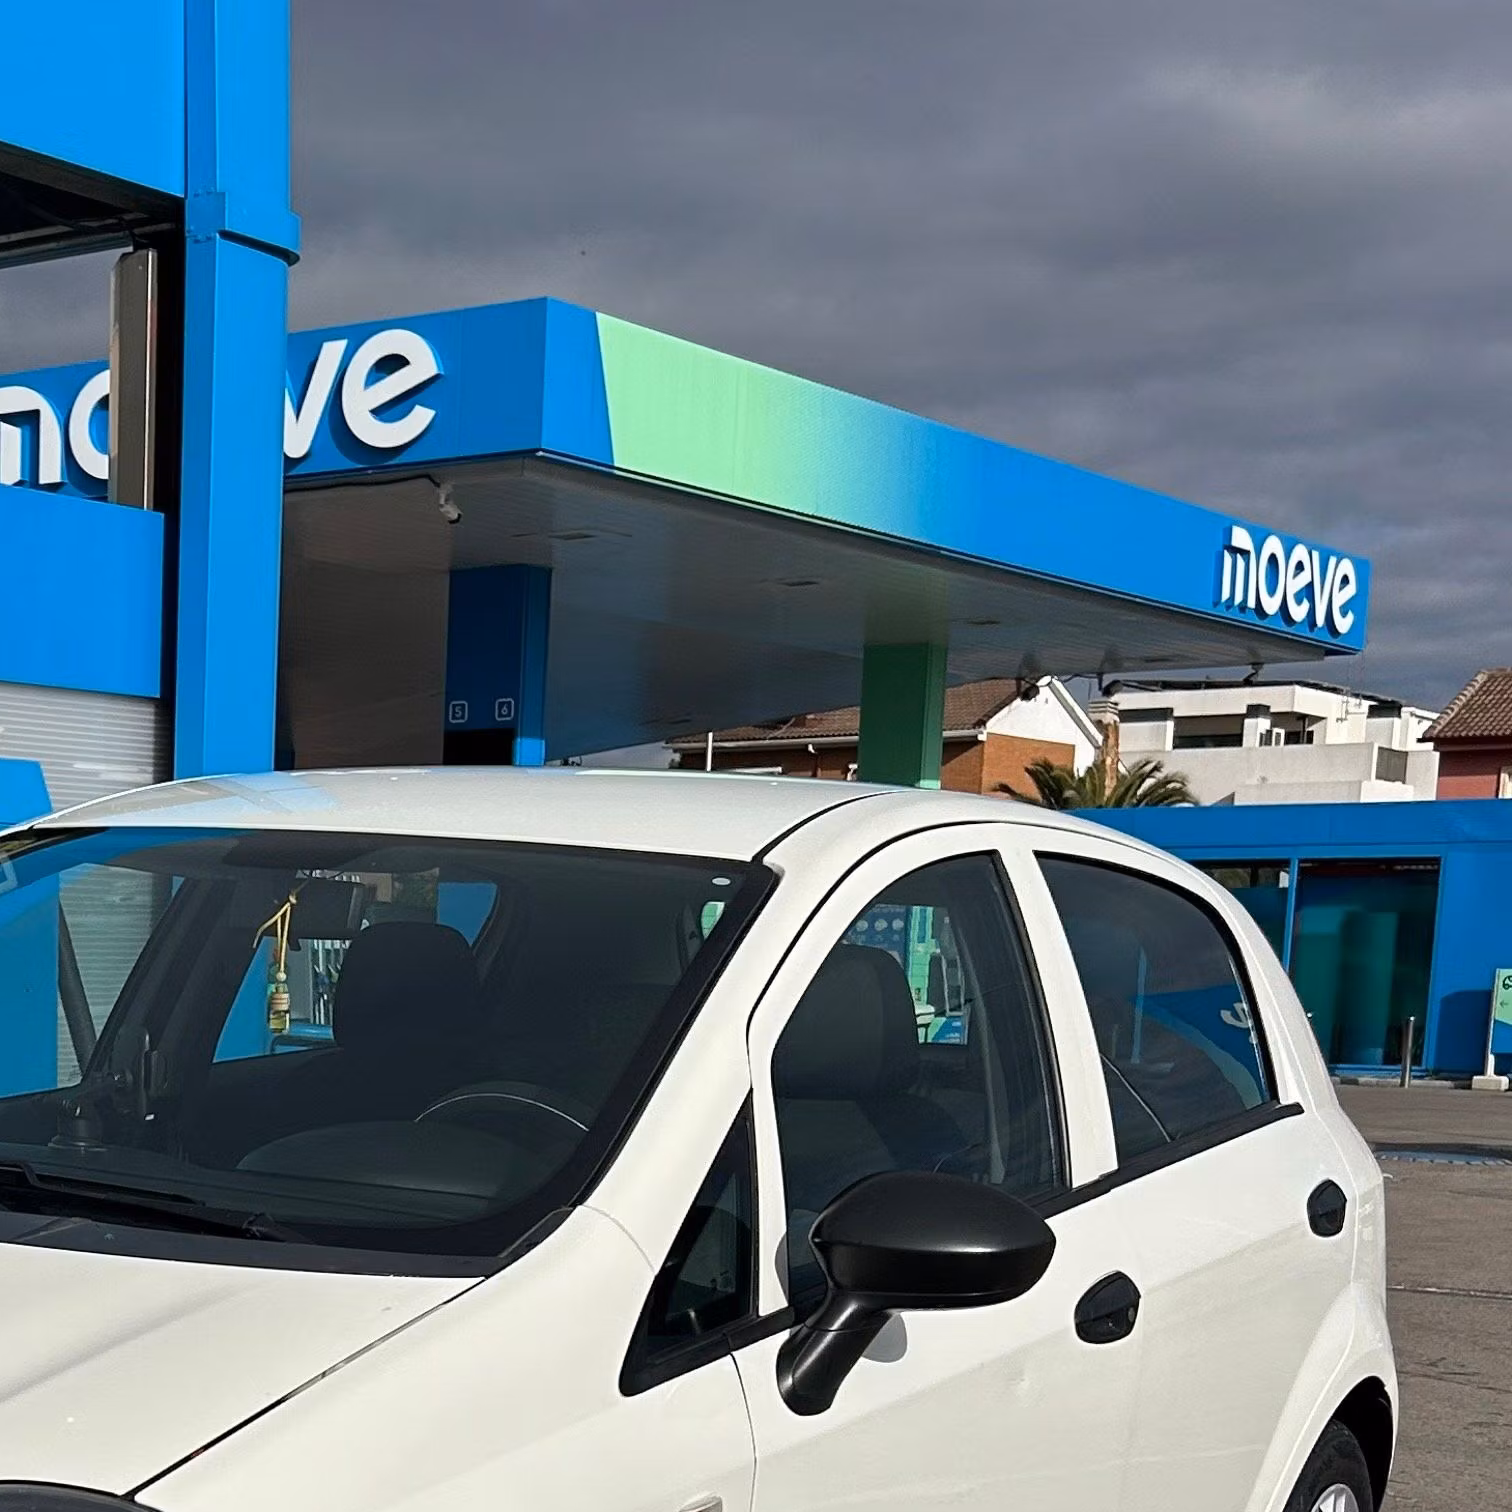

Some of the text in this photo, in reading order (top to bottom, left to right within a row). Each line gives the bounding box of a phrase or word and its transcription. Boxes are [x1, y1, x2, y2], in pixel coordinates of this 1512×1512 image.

[1221, 525, 1357, 635] moeve
[454, 705, 463, 718] 5
[500, 703, 509, 716] 6
